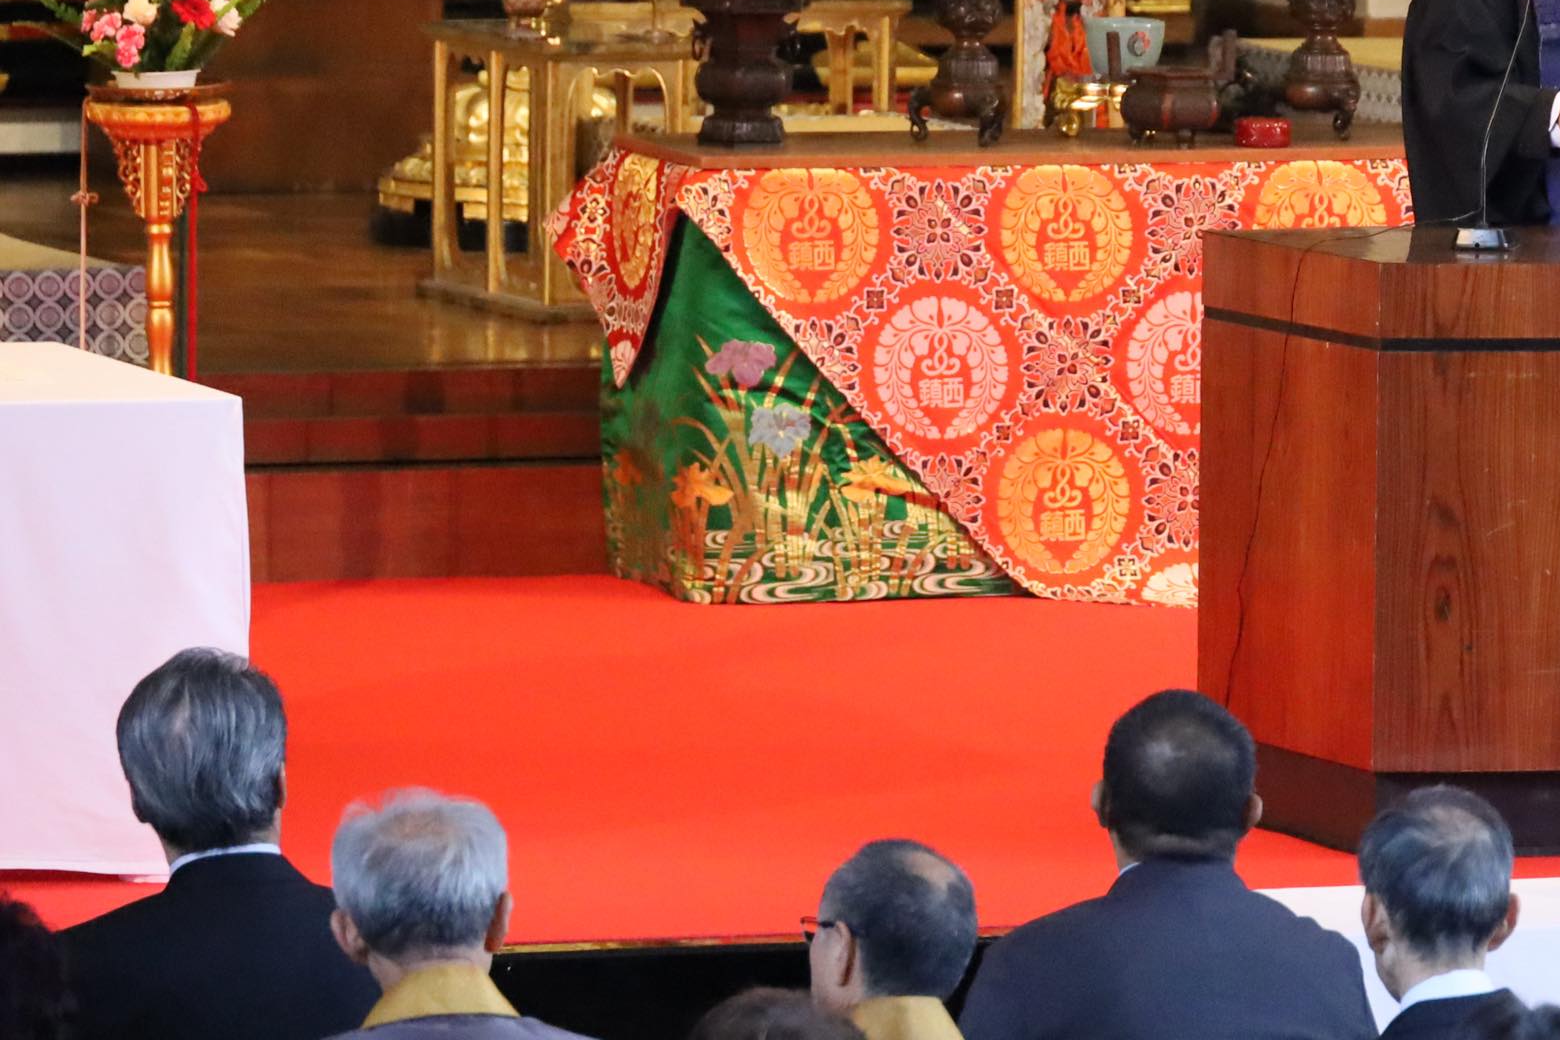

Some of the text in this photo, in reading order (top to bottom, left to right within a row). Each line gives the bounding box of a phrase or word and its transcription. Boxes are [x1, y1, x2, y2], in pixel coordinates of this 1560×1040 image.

[788, 240, 835, 271] 鎮西
[1043, 240, 1090, 271] 鎮西
[918, 377, 964, 408] 鎮西
[1170, 374, 1201, 405] 鎮
[1040, 509, 1086, 541] 鎮西
